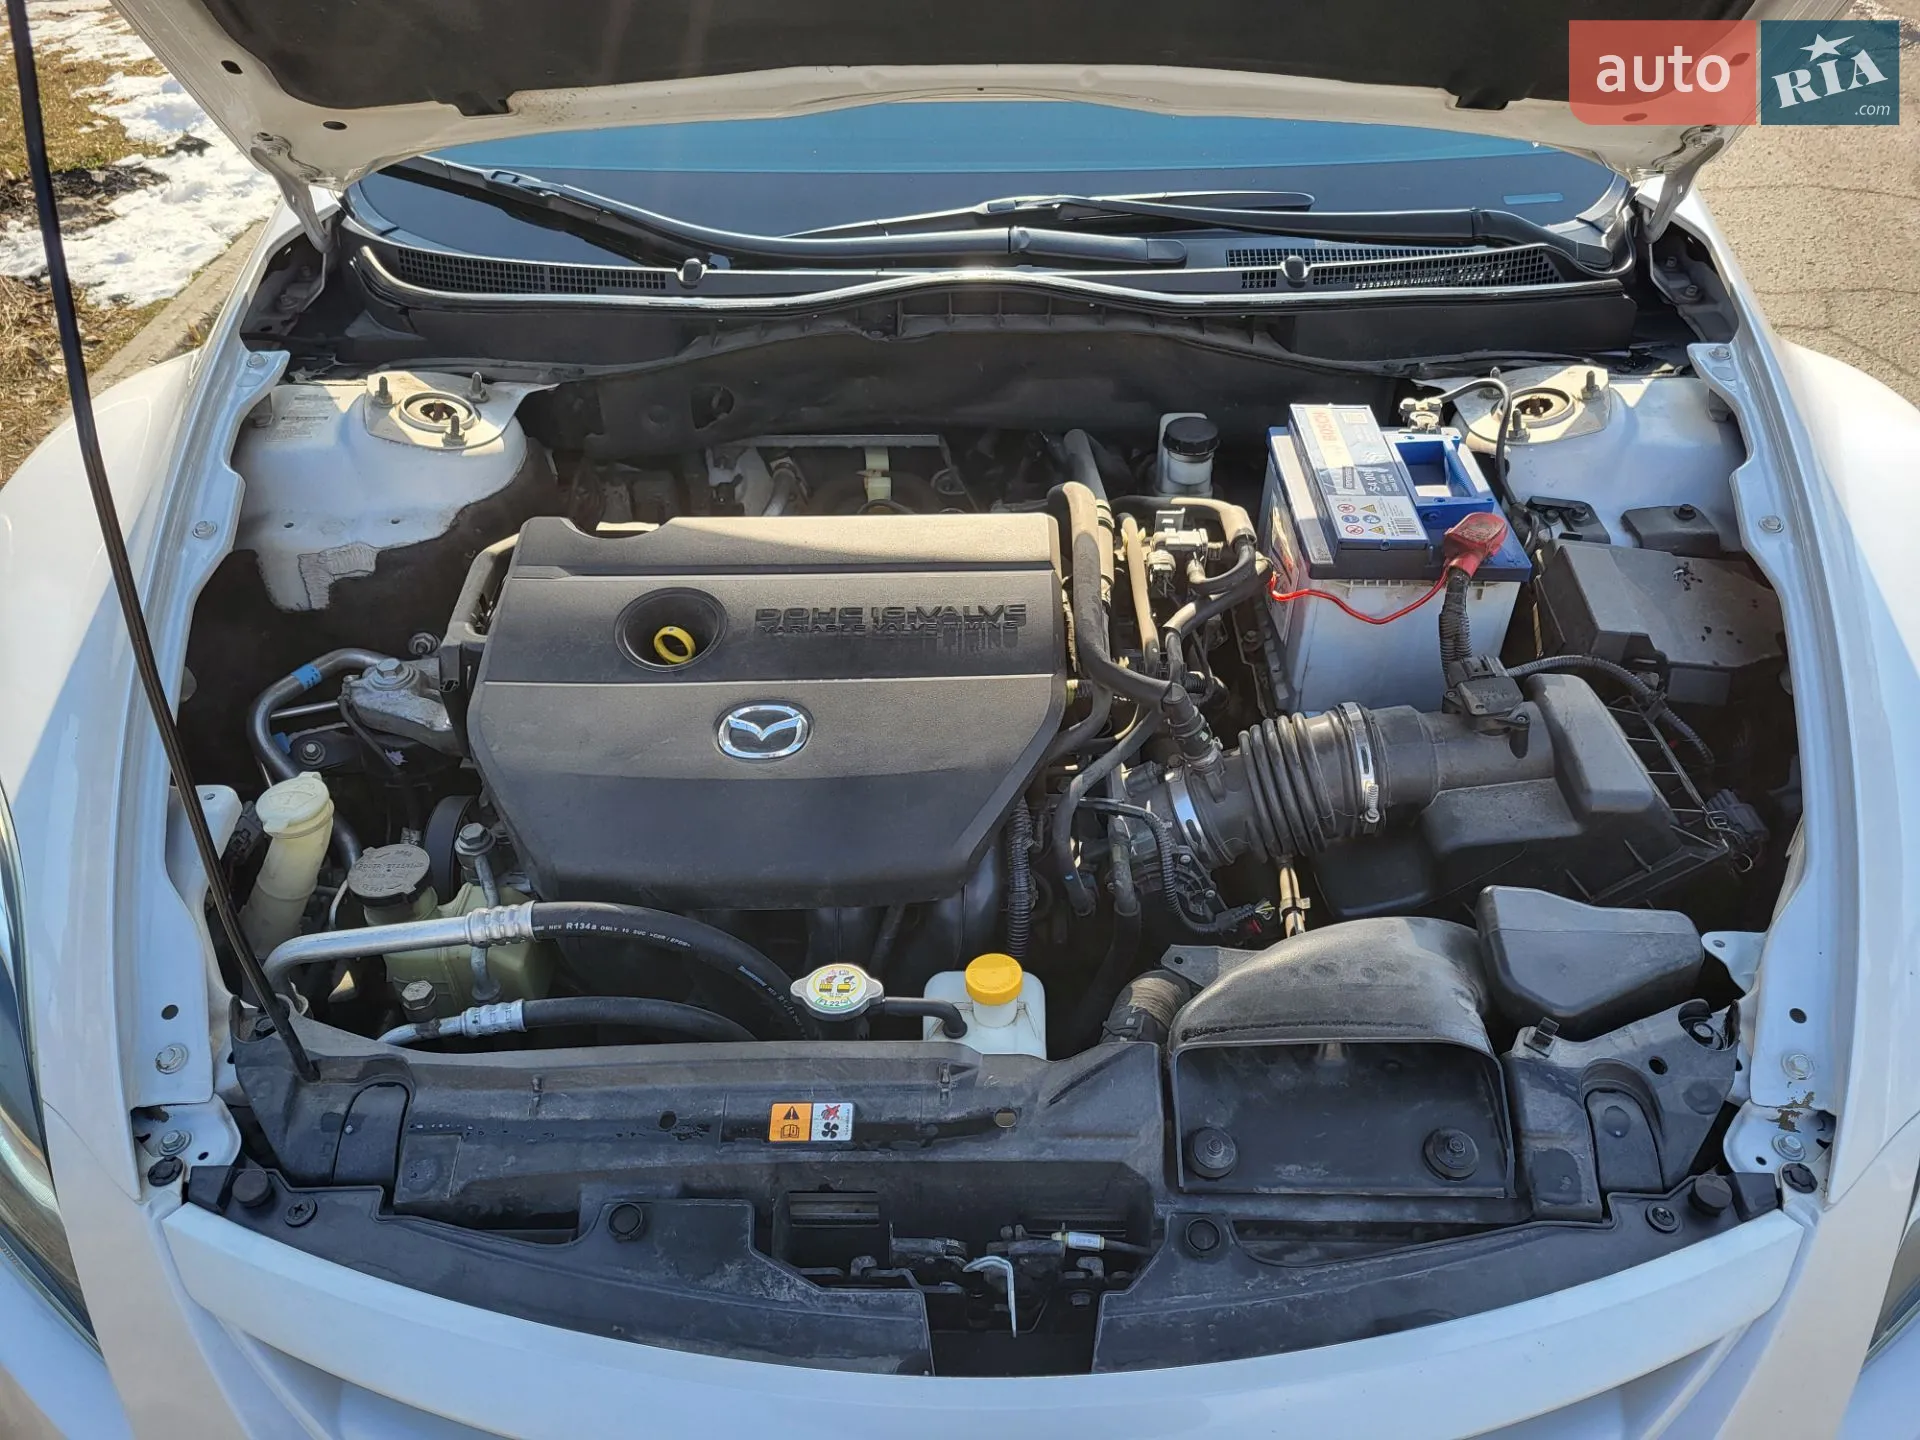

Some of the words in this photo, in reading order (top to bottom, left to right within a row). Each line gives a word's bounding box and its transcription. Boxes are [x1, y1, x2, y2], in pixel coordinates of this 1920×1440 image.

[756, 607, 863, 622] DOHC
[760, 623, 866, 634] VARIABLE
[873, 621, 938, 633] VALVE
[565, 922, 597, 931] R134a
